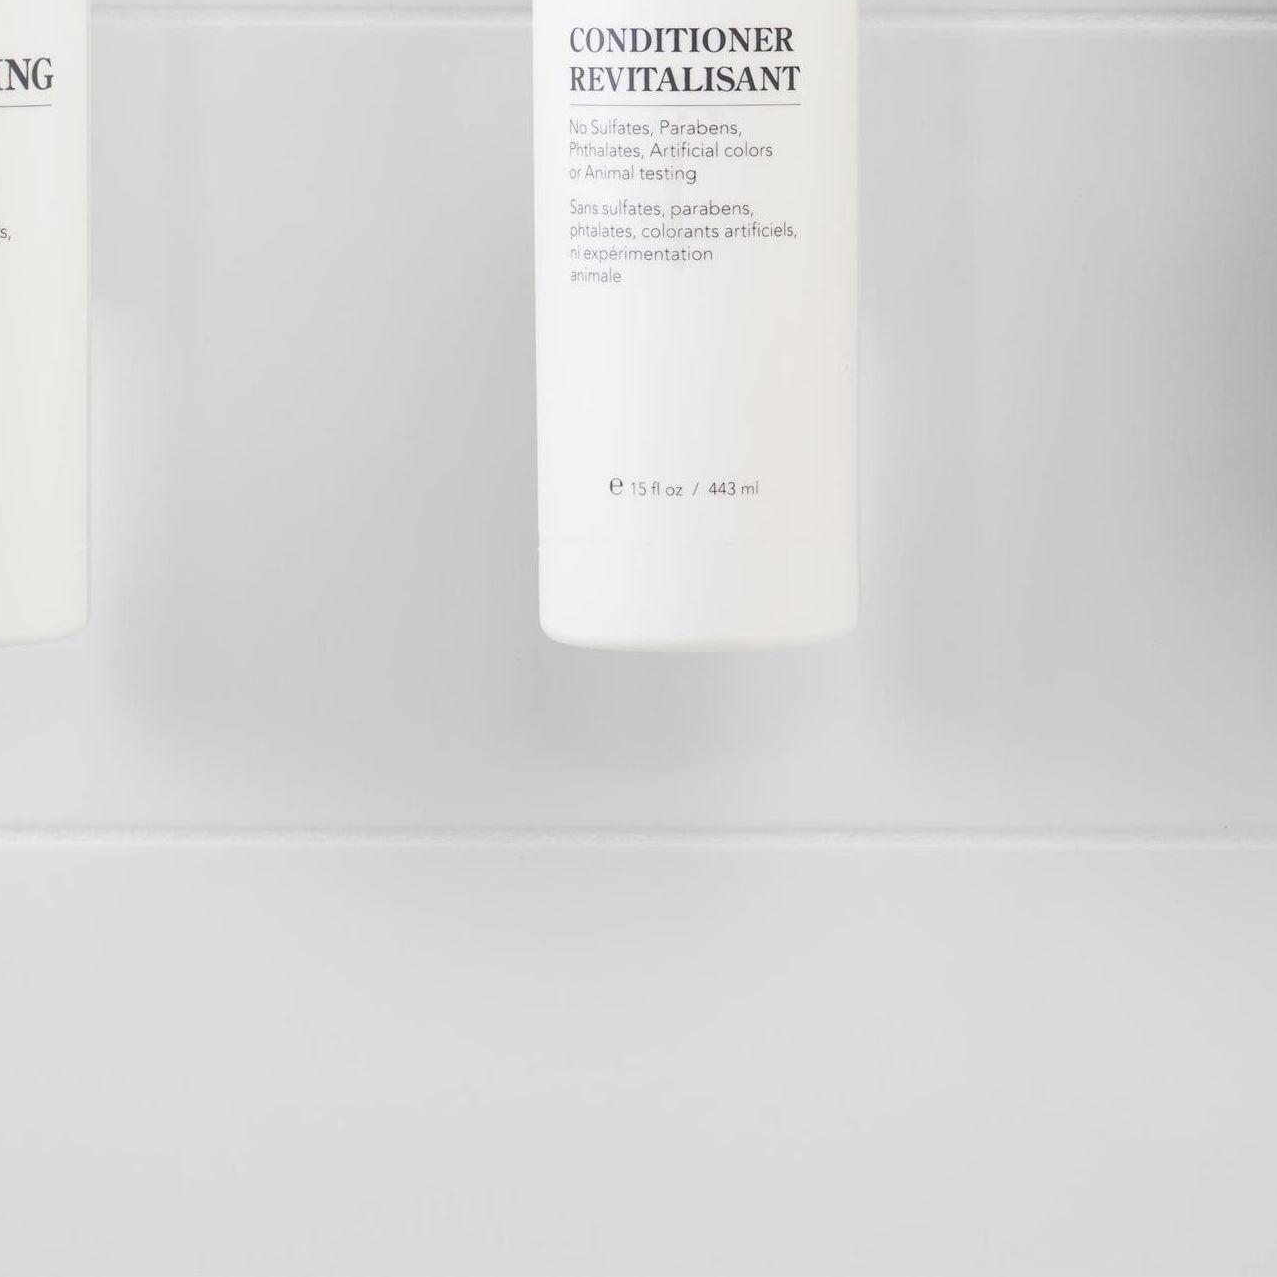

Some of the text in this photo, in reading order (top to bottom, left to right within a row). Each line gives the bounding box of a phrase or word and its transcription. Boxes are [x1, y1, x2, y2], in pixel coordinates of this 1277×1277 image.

[570, 27, 794, 53] CONDITIONER
[570, 66, 801, 92] REVITALISANT
[569, 119, 742, 137] No Sulfates, Parabens,
[569, 142, 773, 159] Phthalates, Artificial colors
[569, 165, 697, 184] or Animal testing
[570, 200, 754, 219] Sans sulfates, parabens,
[570, 221, 797, 240] phtalates, colorants artificiels,
[570, 246, 713, 264] ni expérimentation
[570, 268, 622, 284] animale
[631, 481, 647, 496] 15
[651, 481, 660, 496] fl
[666, 485, 683, 497] oz
[708, 481, 736, 496] 443
[741, 480, 759, 495] ml
